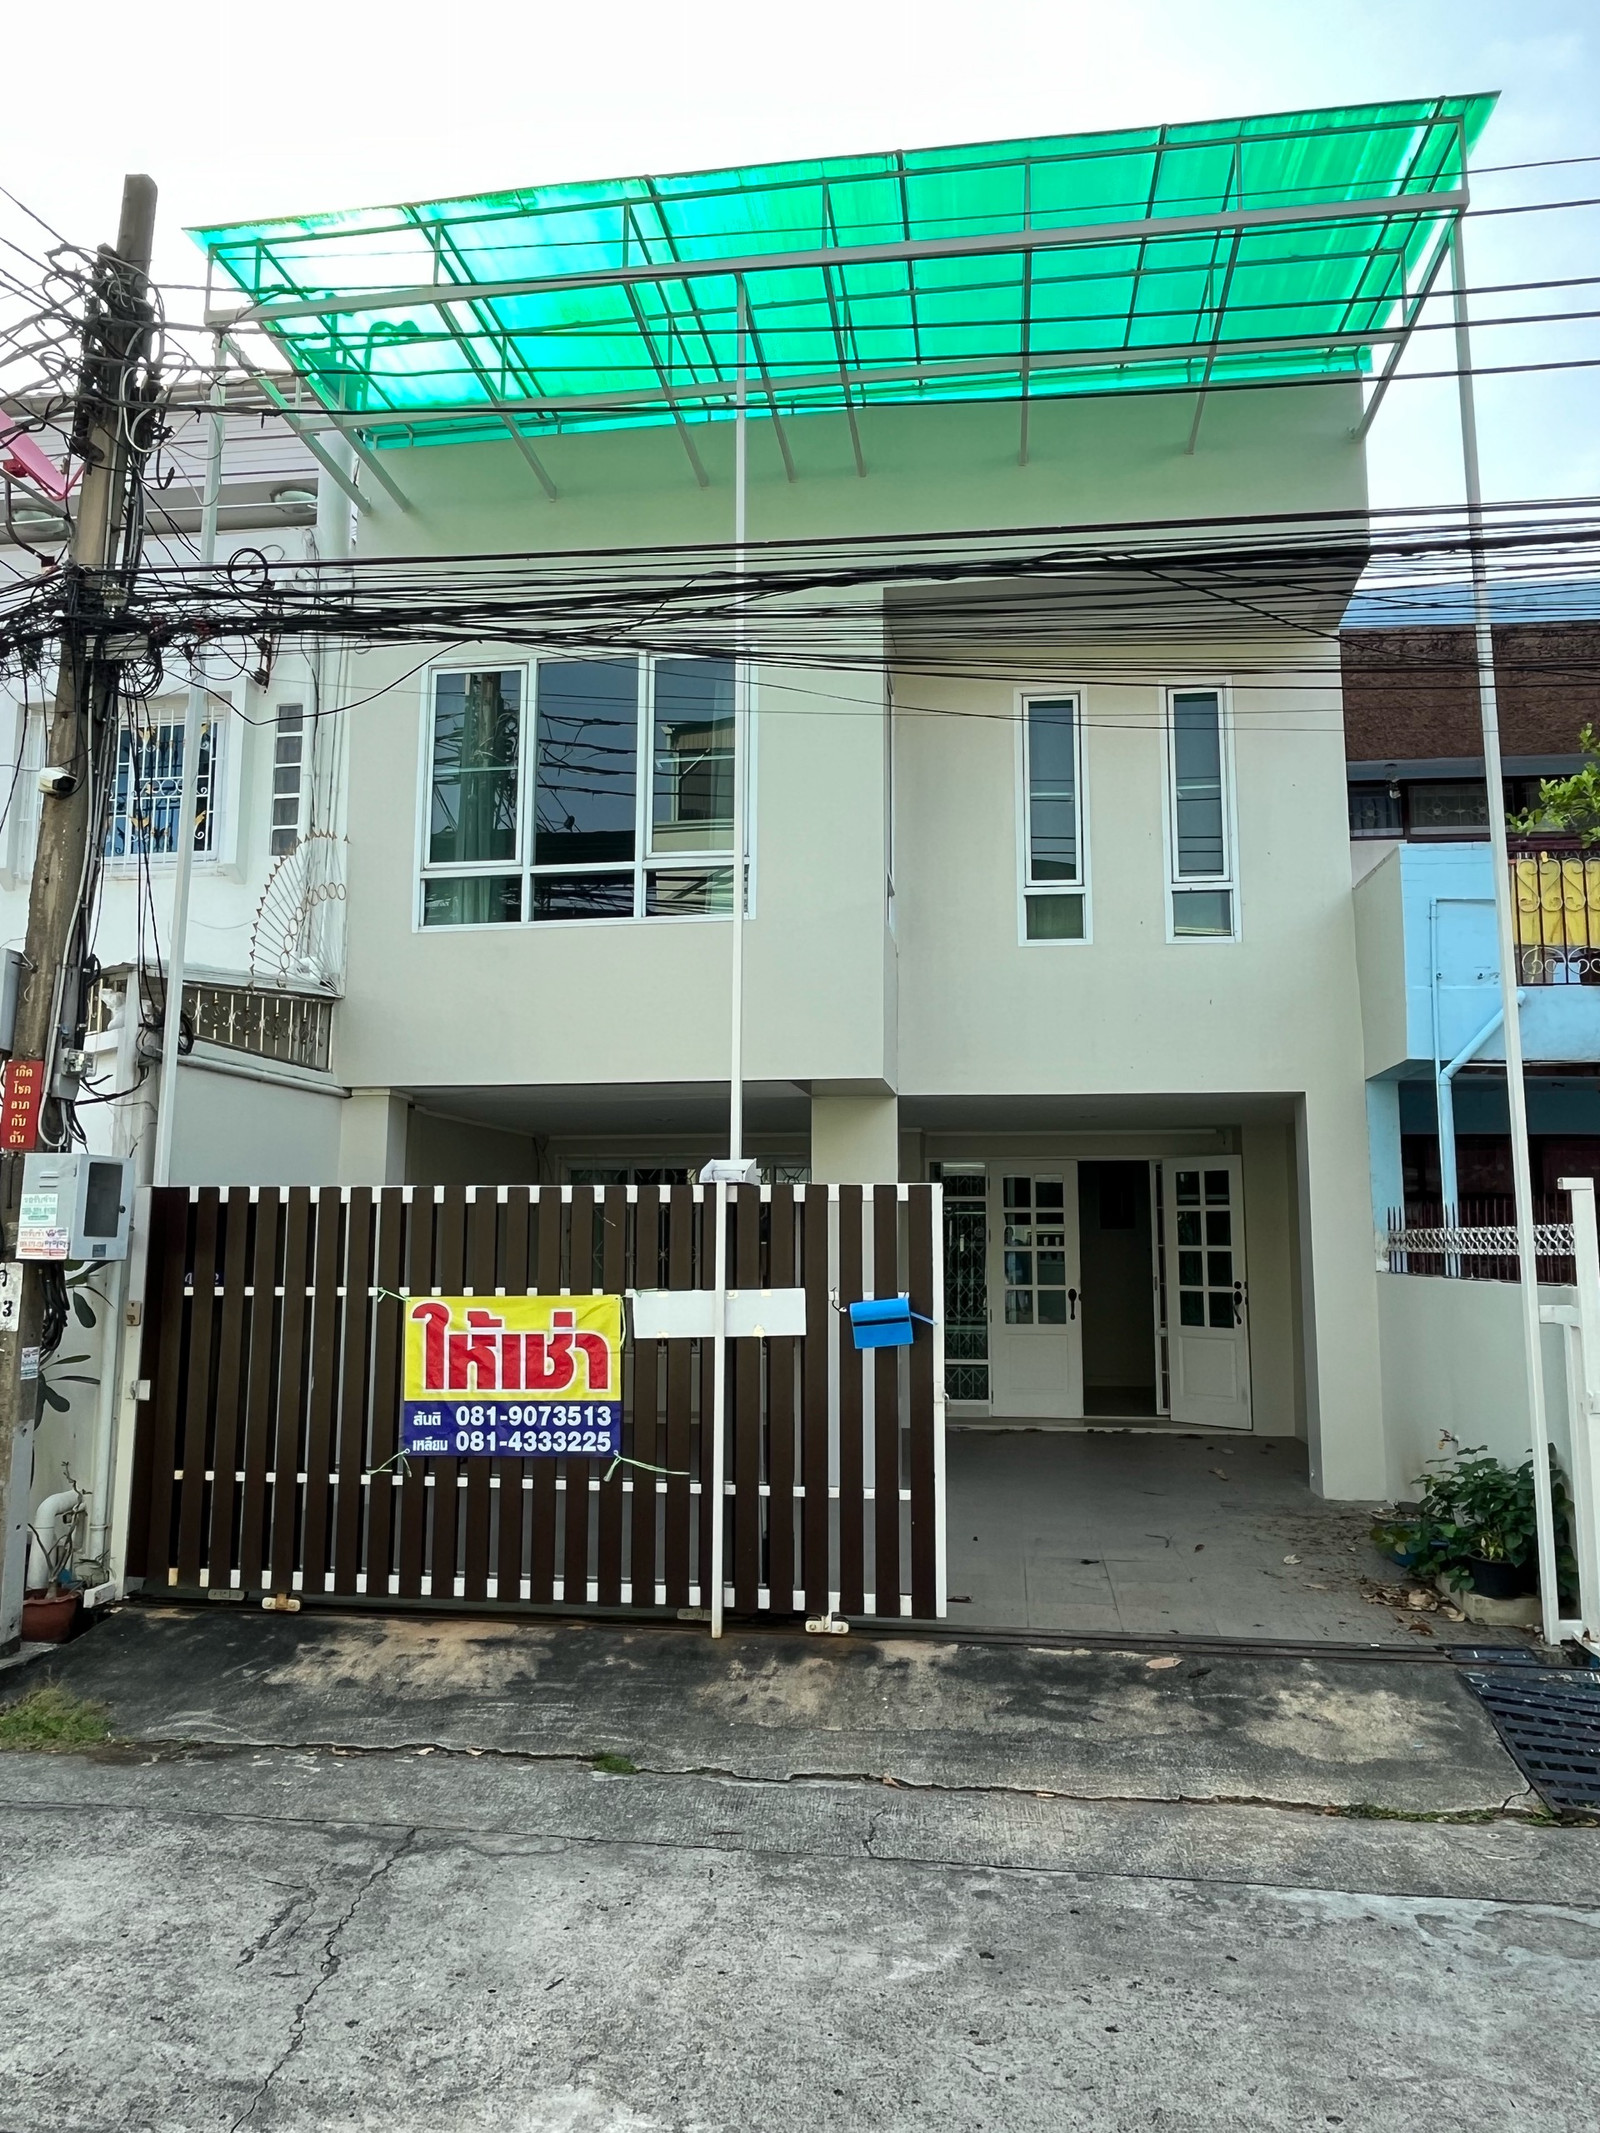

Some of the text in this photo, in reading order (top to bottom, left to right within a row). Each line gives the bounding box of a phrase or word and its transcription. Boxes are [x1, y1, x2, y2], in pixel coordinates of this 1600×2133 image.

[11, 1114, 27, 1127] กับ
[411, 1302, 609, 1391] ให้เช่า
[412, 1405, 612, 1427] สันติ 081-9073513
[455, 1430, 612, 1452] 081-4333225
